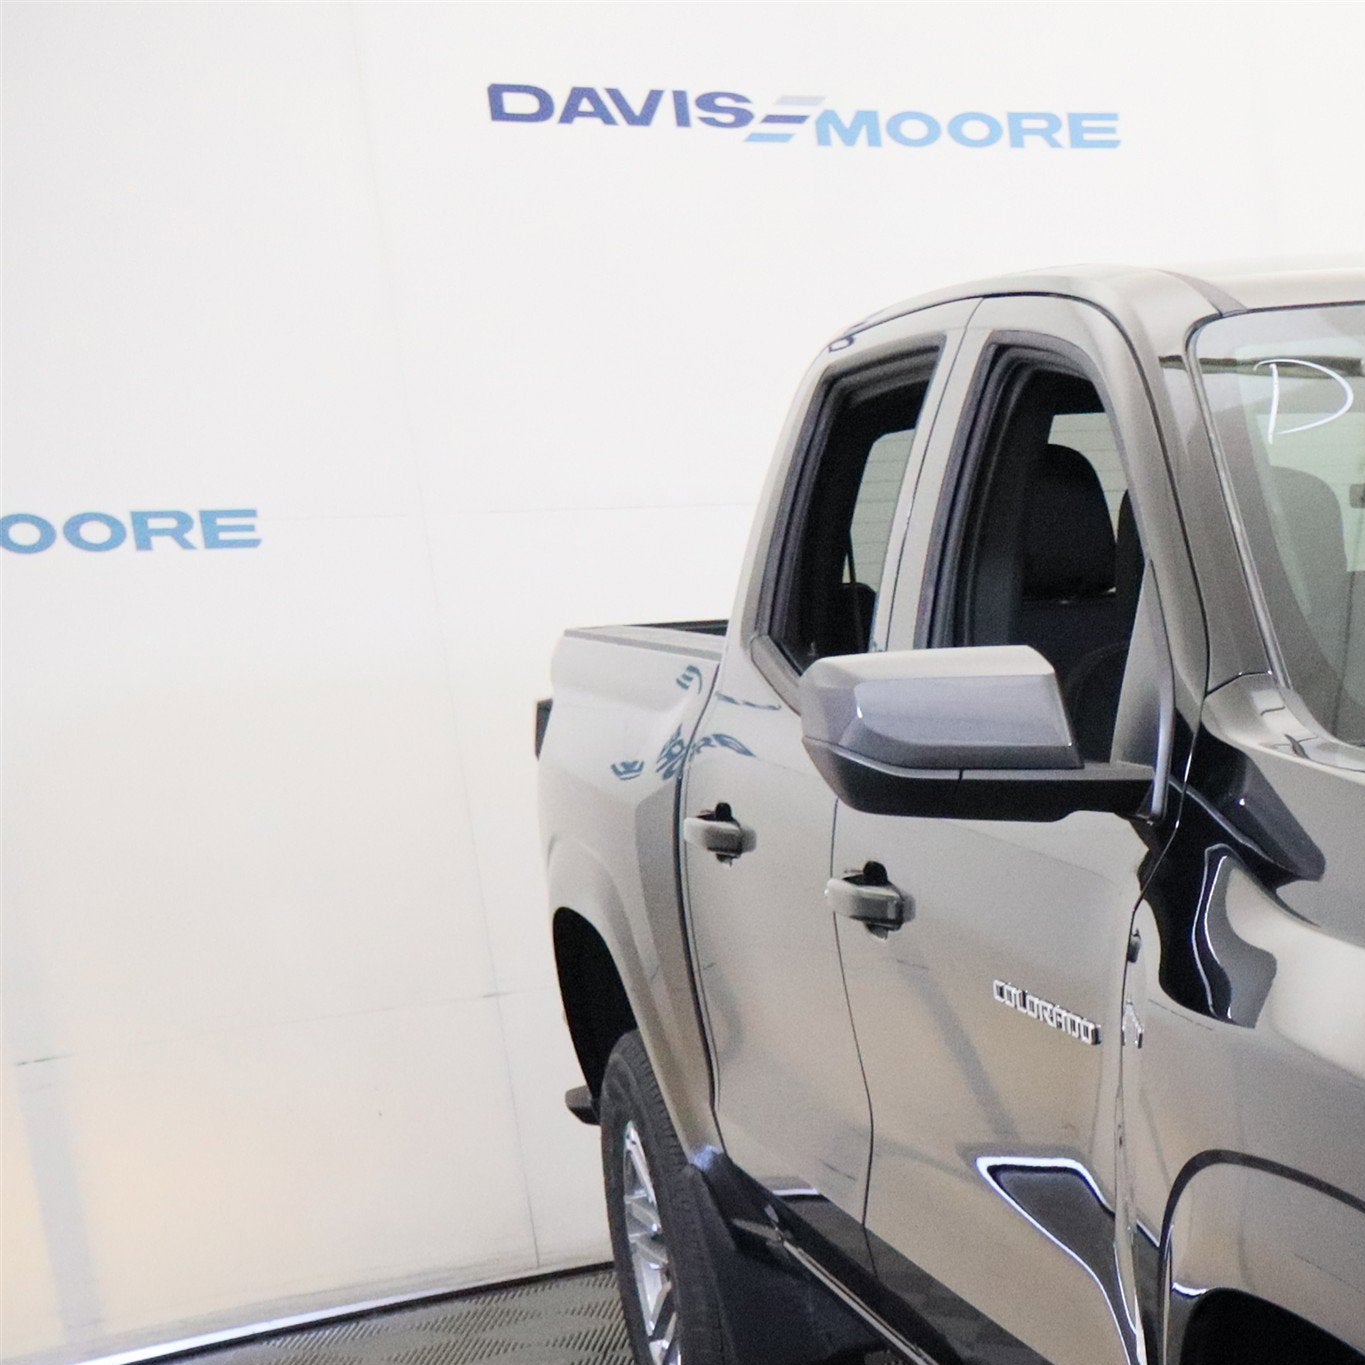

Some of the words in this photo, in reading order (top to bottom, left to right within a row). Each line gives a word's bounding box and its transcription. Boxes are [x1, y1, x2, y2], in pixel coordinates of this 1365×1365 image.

[487, 83, 754, 129] DAVIS
[815, 108, 1122, 150] MOORE
[993, 979, 1102, 1045] COLORADO
